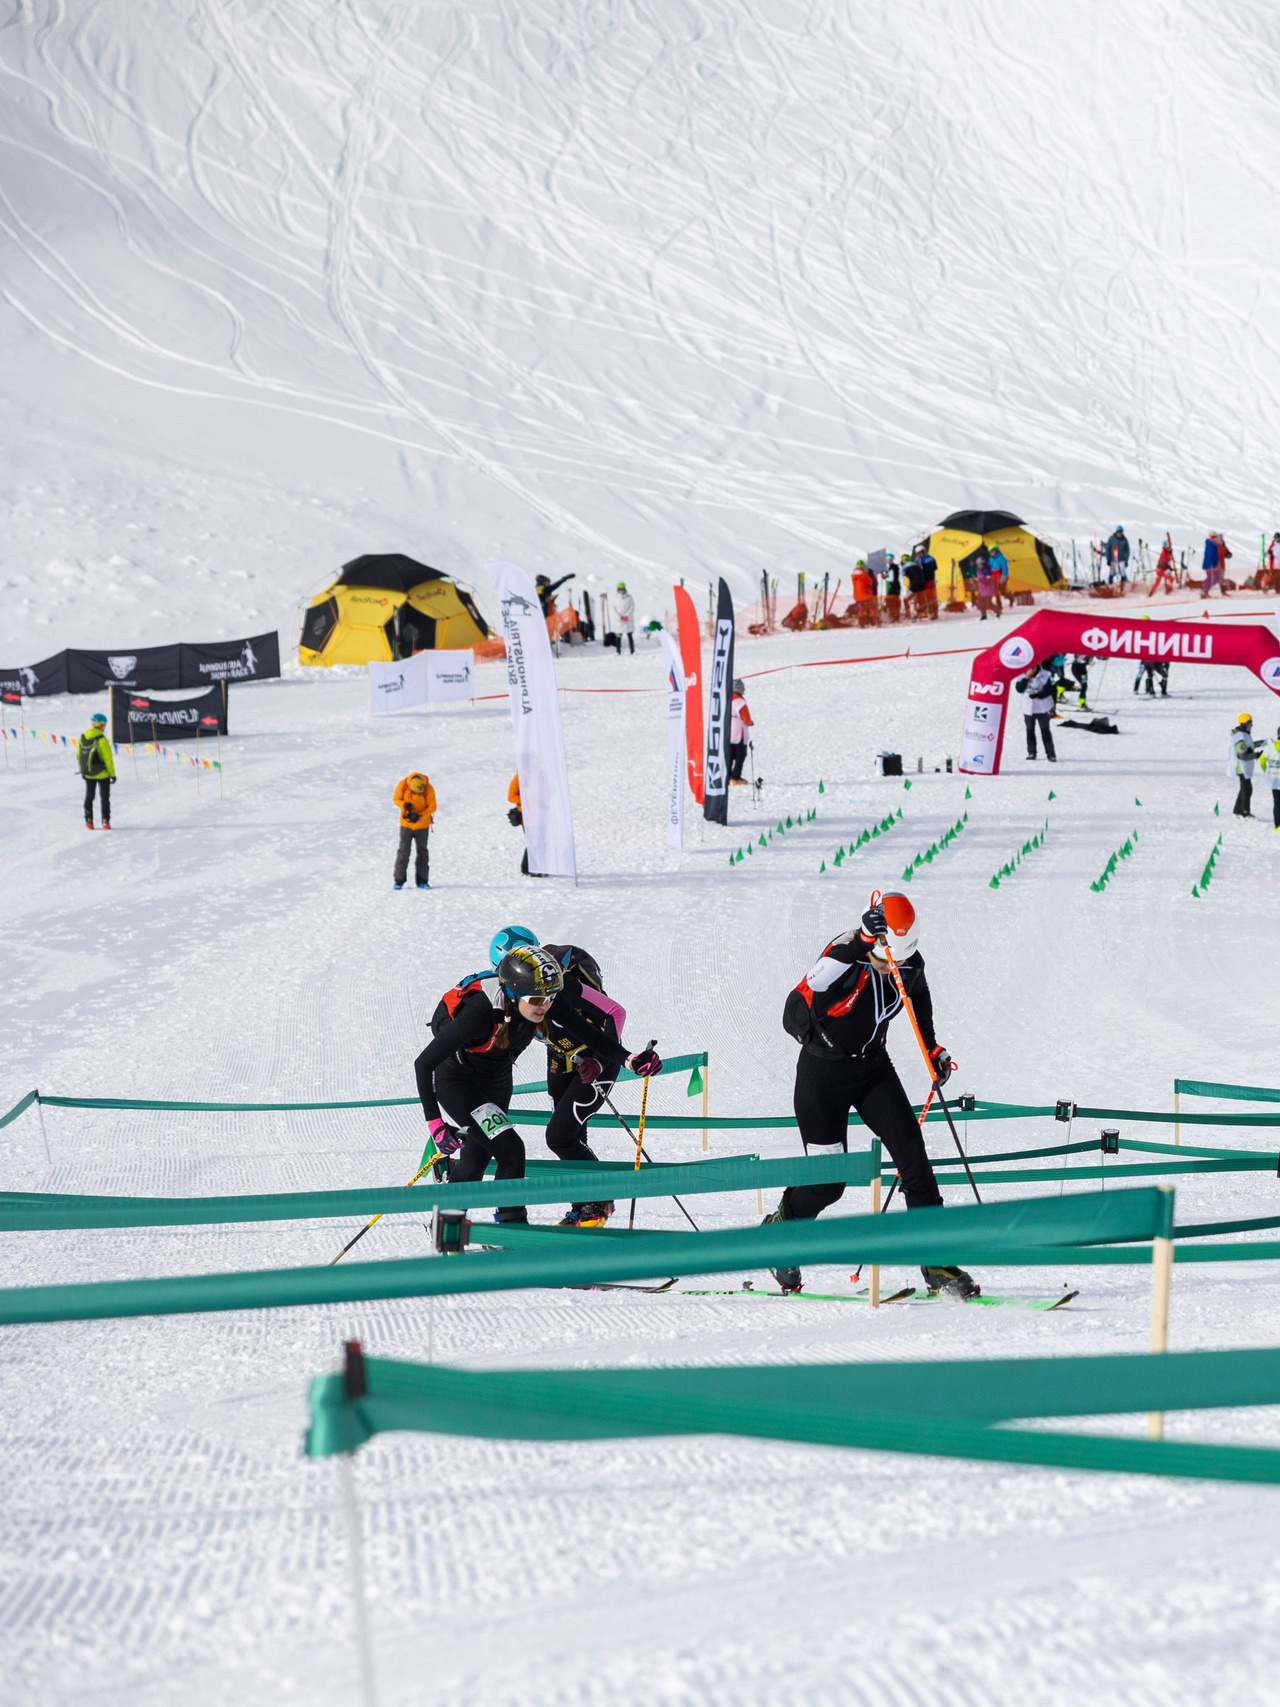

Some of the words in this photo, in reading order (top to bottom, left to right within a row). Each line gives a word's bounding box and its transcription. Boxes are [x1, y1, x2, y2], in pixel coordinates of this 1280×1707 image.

[1081, 628, 1213, 658] ФИНИШ
[482, 1113, 509, 1132] 201
[412, 1156, 438, 1183] carbon
